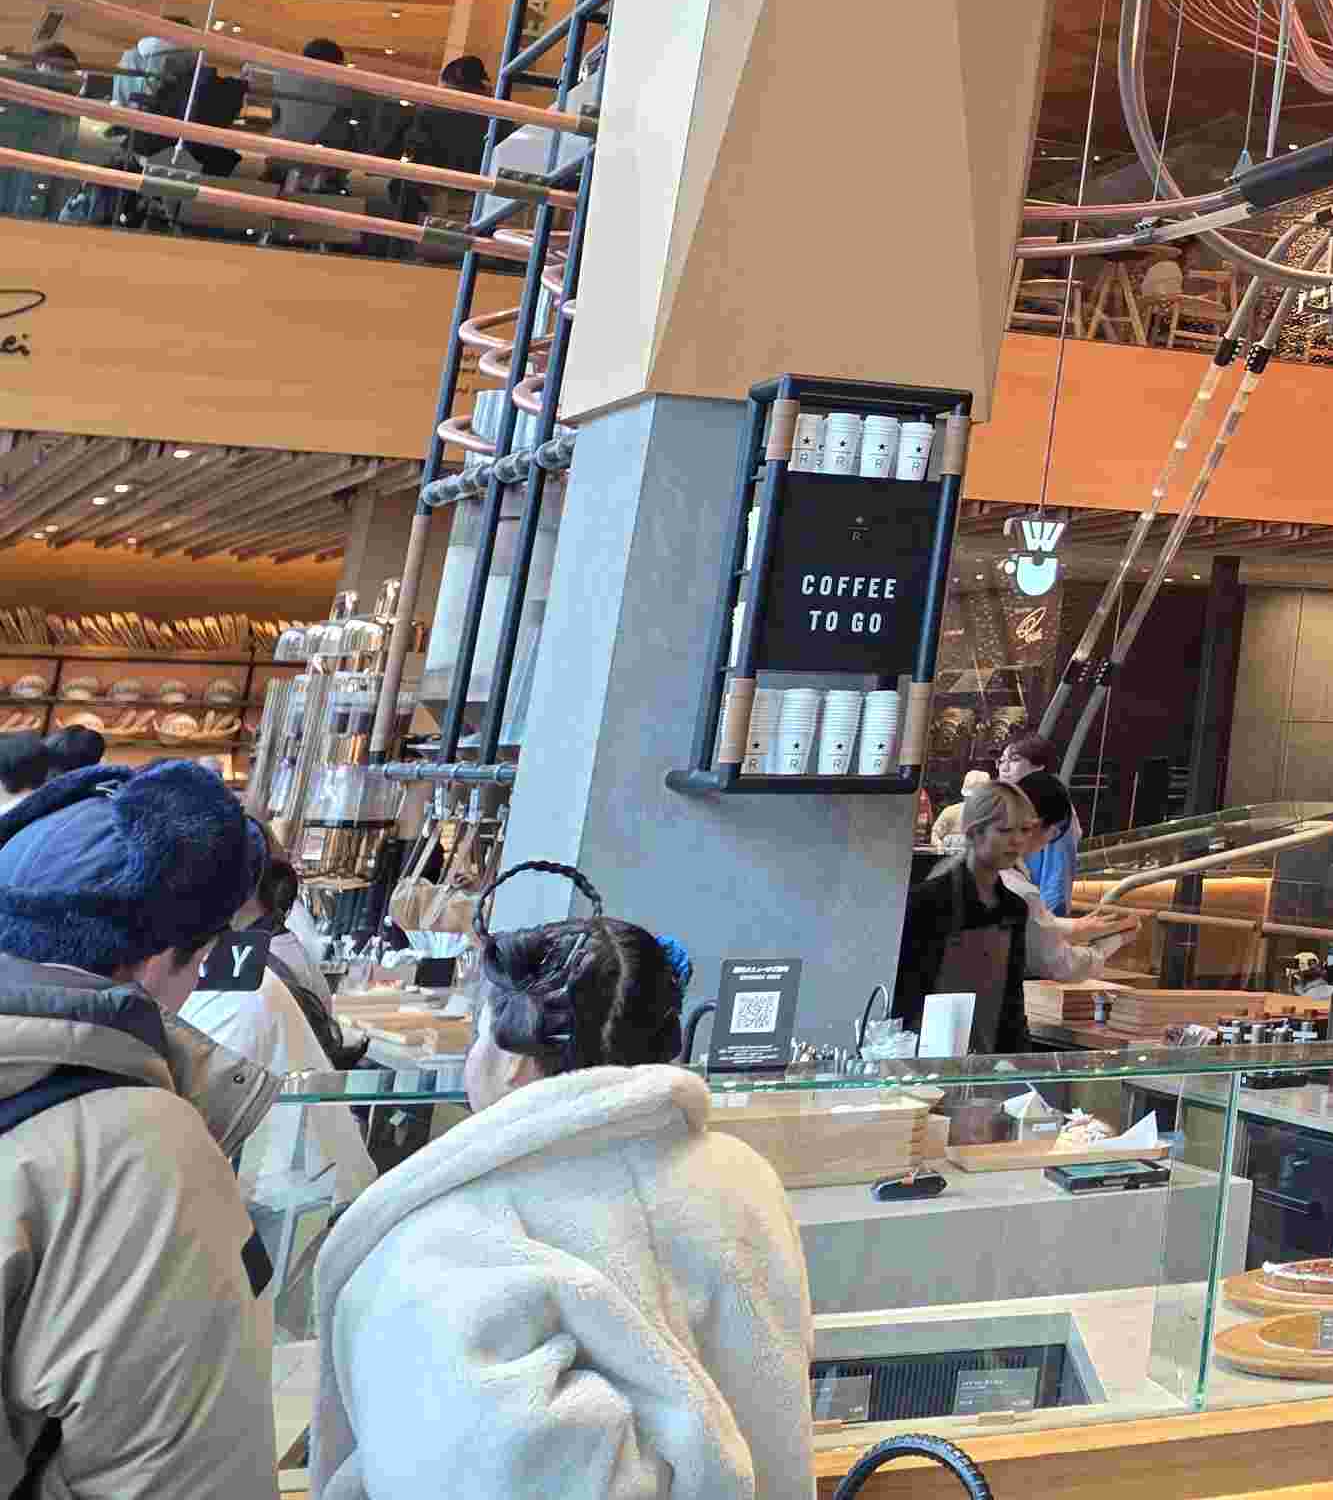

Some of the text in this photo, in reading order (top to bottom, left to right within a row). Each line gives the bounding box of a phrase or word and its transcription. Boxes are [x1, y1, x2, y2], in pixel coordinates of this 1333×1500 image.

[801, 574, 897, 599] COFFEE
[808, 610, 882, 633] TO GO
